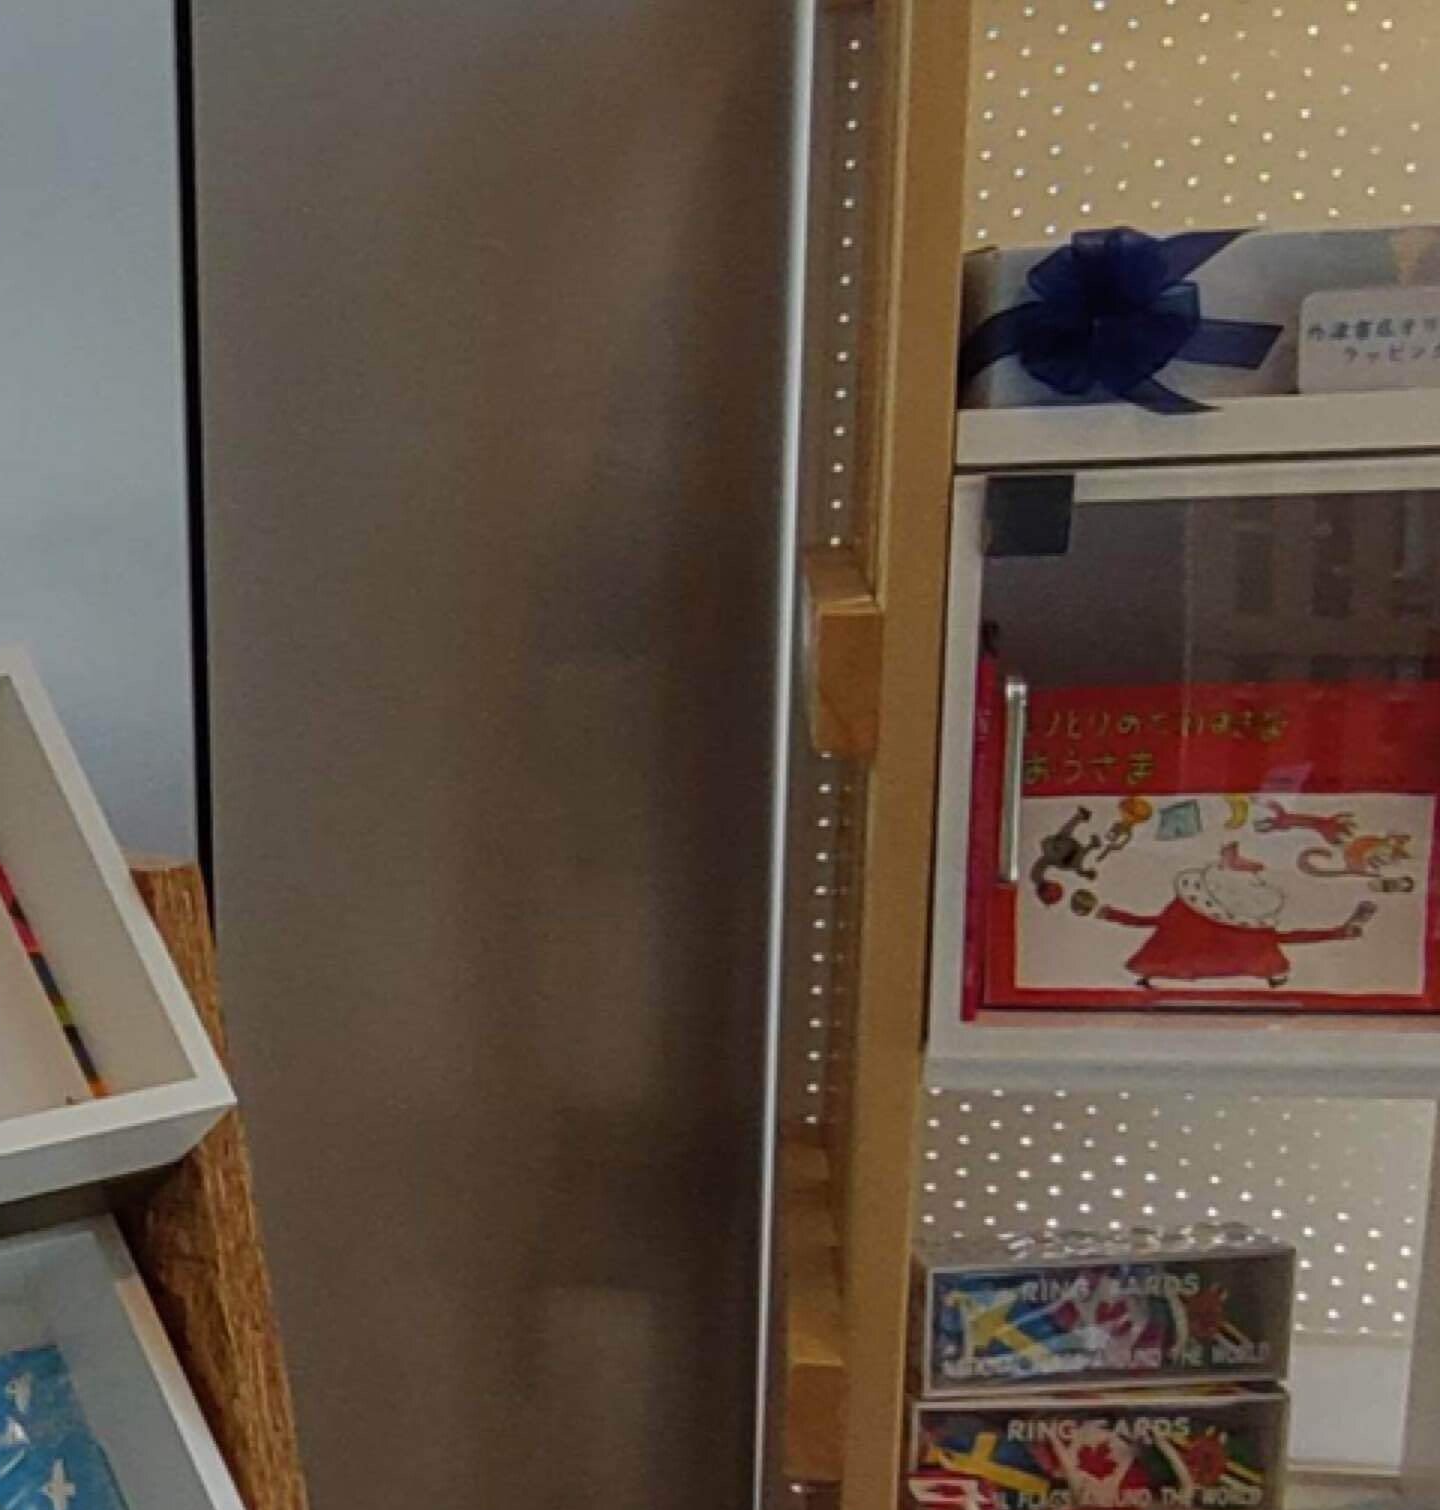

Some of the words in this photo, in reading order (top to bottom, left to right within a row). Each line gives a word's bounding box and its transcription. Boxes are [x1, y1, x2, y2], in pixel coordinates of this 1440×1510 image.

[1024, 748, 1154, 786] おうさま
[1007, 1419, 1078, 1443] RING
